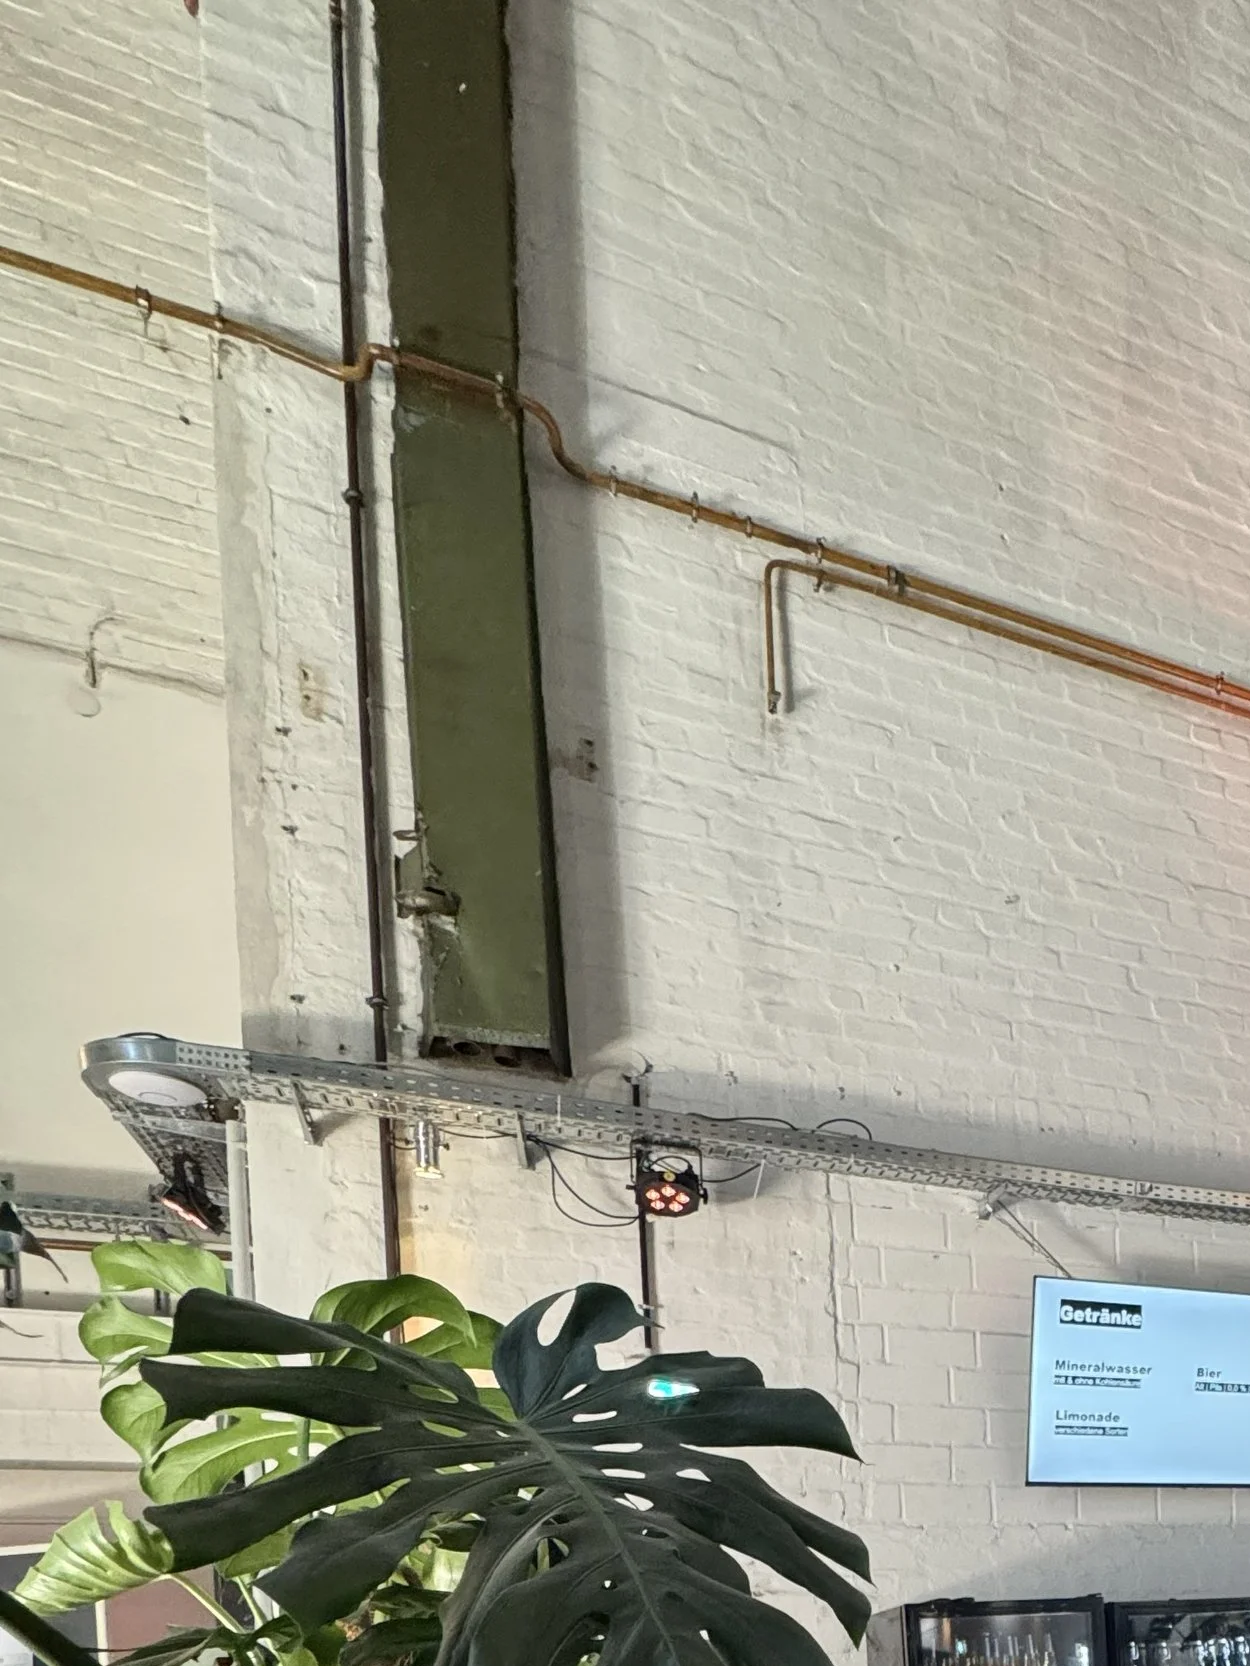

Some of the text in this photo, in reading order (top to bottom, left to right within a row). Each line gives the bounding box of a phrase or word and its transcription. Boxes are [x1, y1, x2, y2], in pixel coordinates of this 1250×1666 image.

[1060, 1304, 1142, 1327] Getränke
[1055, 1360, 1152, 1375] Mineralwasser
[1197, 1367, 1222, 1378] Bier
[1075, 1377, 1094, 1385] ohne
[1056, 1409, 1120, 1423] Limonade
